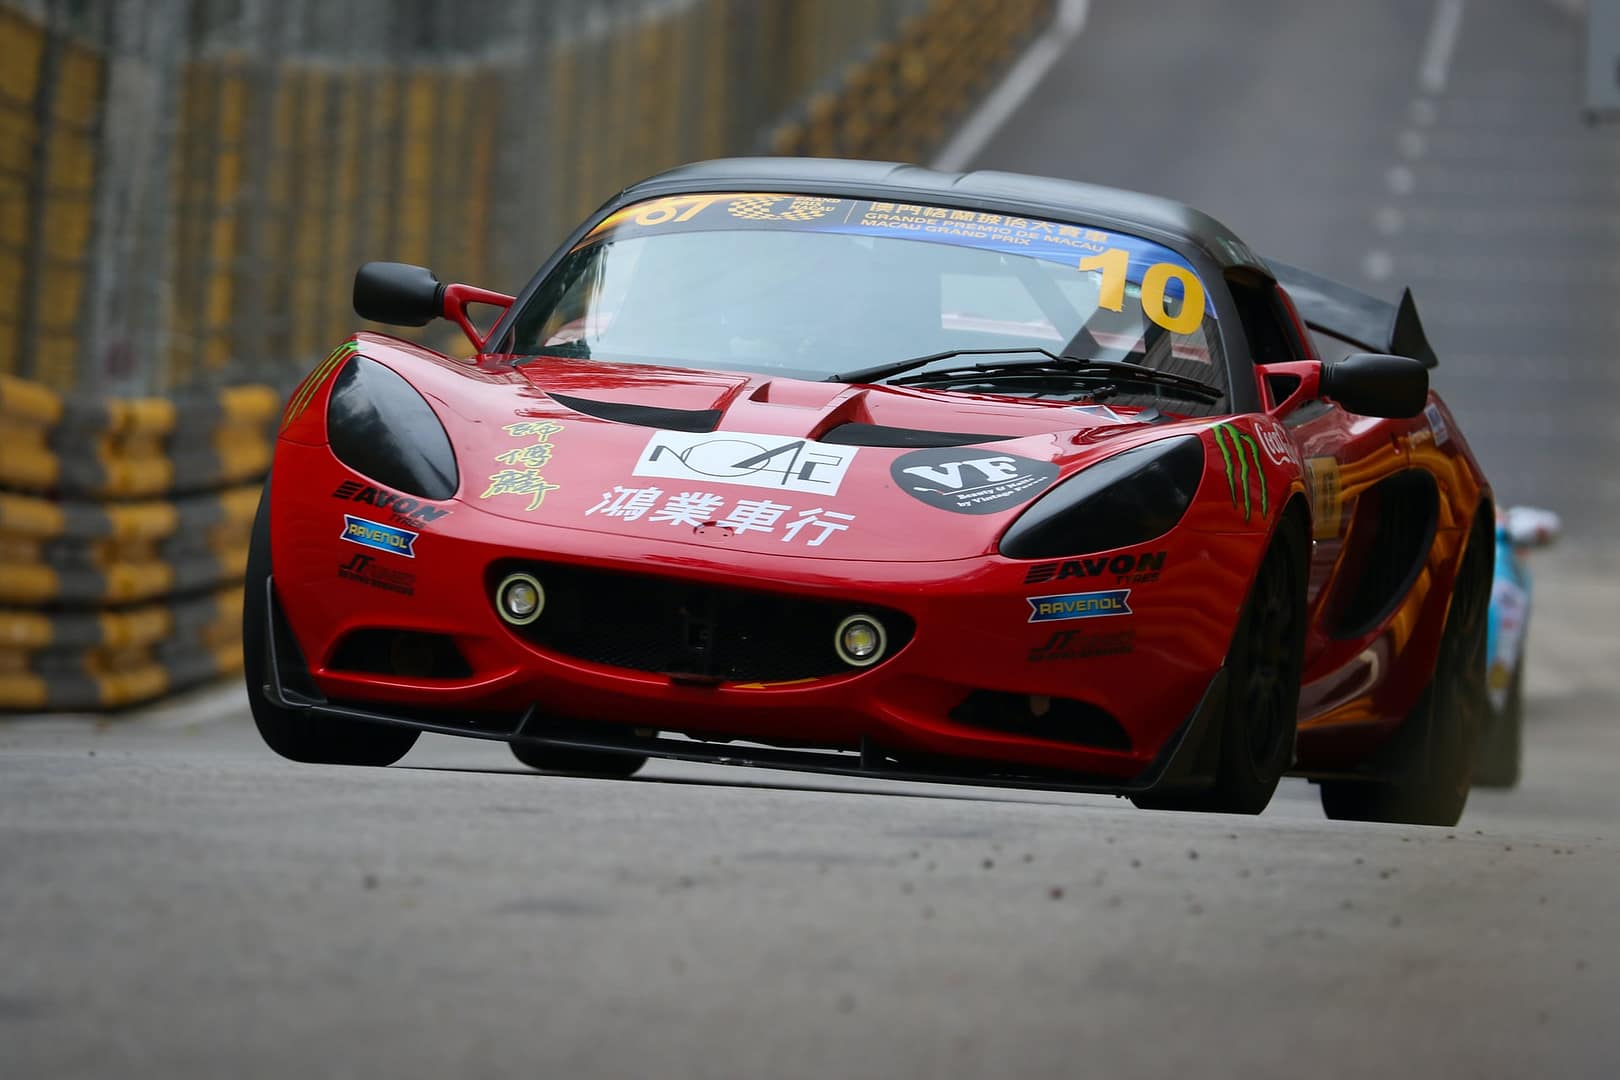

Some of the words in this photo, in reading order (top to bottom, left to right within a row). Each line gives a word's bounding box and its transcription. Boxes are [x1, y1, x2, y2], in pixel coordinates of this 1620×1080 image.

[860, 219, 921, 232] MACAU
[925, 225, 988, 239] GRAND
[991, 233, 1032, 246] PRIX
[864, 212, 938, 226] GRANDE
[1015, 229, 1041, 240] DE
[1043, 234, 1104, 253] MACAU
[1078, 247, 1206, 335] 10
[902, 456, 1018, 489] VF
[352, 485, 450, 522] AVON
[972, 490, 1014, 504] Vintage
[585, 485, 857, 547] 鴻業車行
[348, 523, 408, 549] RAVENOL
[1055, 551, 1168, 580] AVON
[1115, 572, 1161, 586] TYRES
[1039, 597, 1122, 616] RAVENOL
